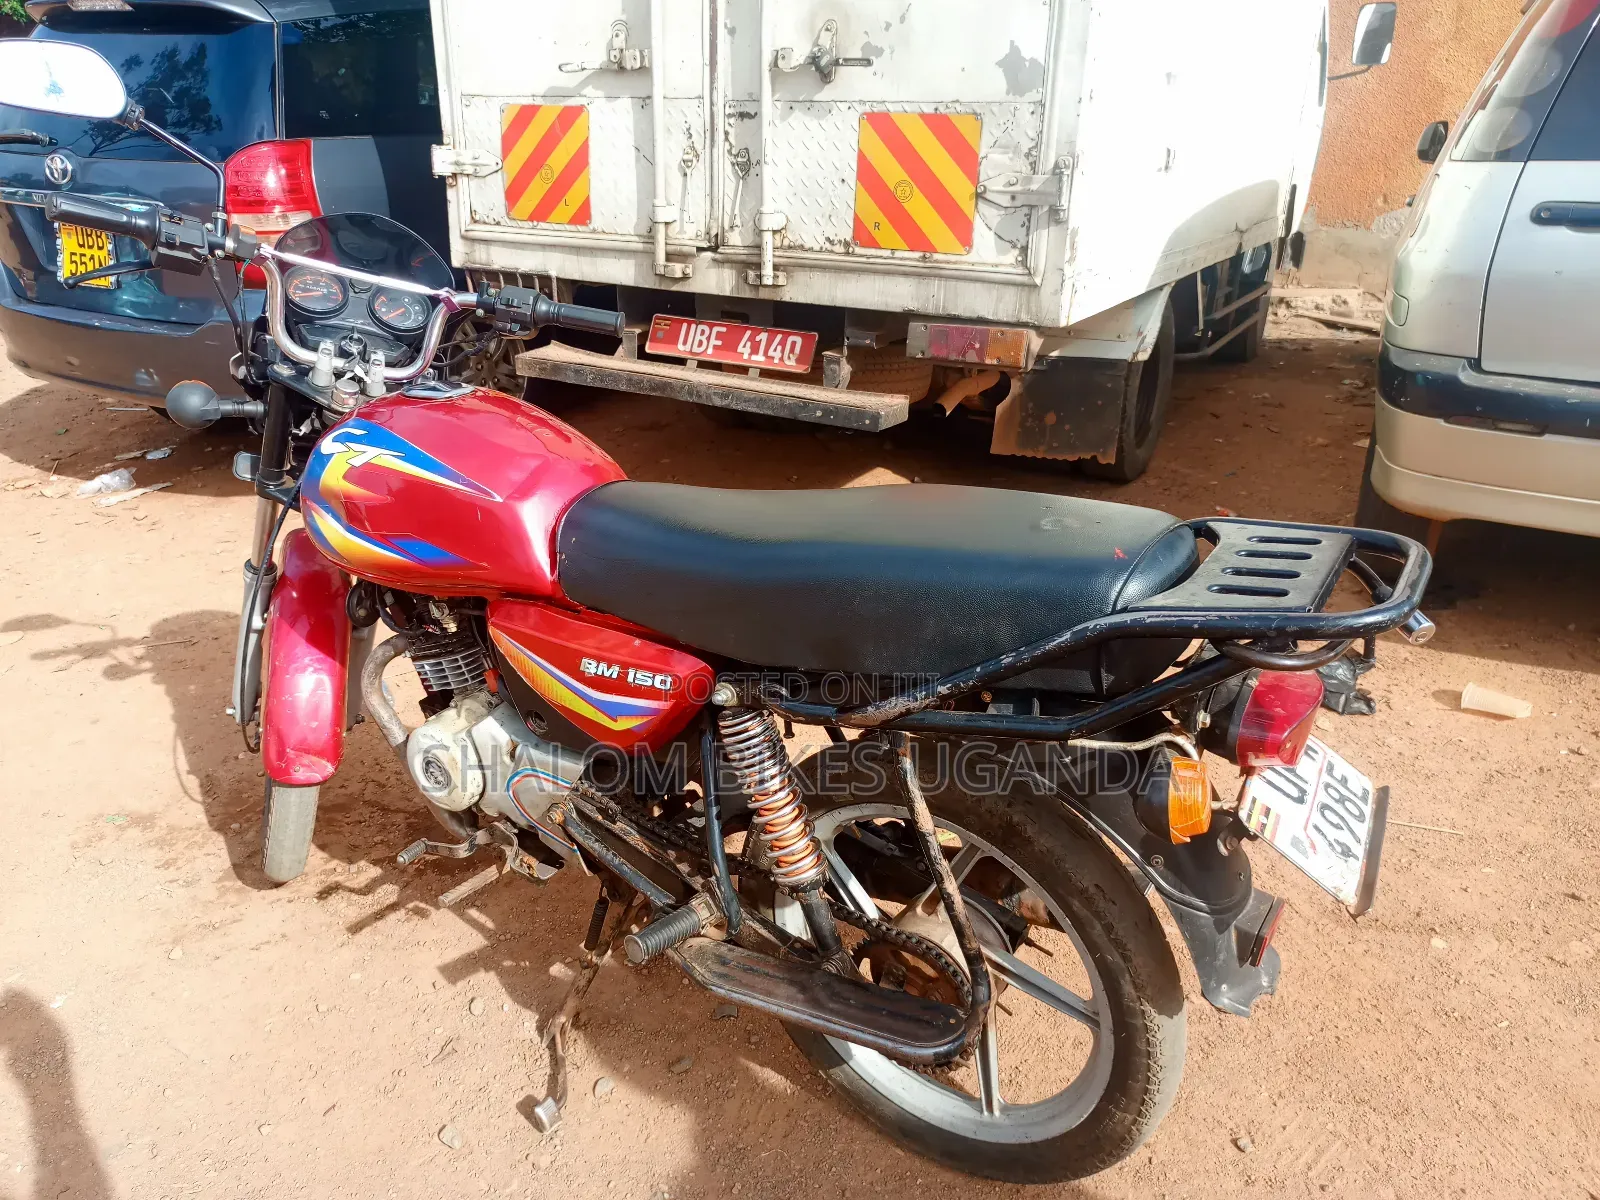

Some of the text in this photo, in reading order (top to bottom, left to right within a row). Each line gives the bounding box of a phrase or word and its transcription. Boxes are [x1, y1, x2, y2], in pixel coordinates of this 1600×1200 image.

[564, 198, 570, 207] L
[873, 221, 881, 231] R
[677, 322, 803, 366] UBF 414Q
[579, 657, 672, 690] BM 150
[1312, 760, 1370, 862] 498E
